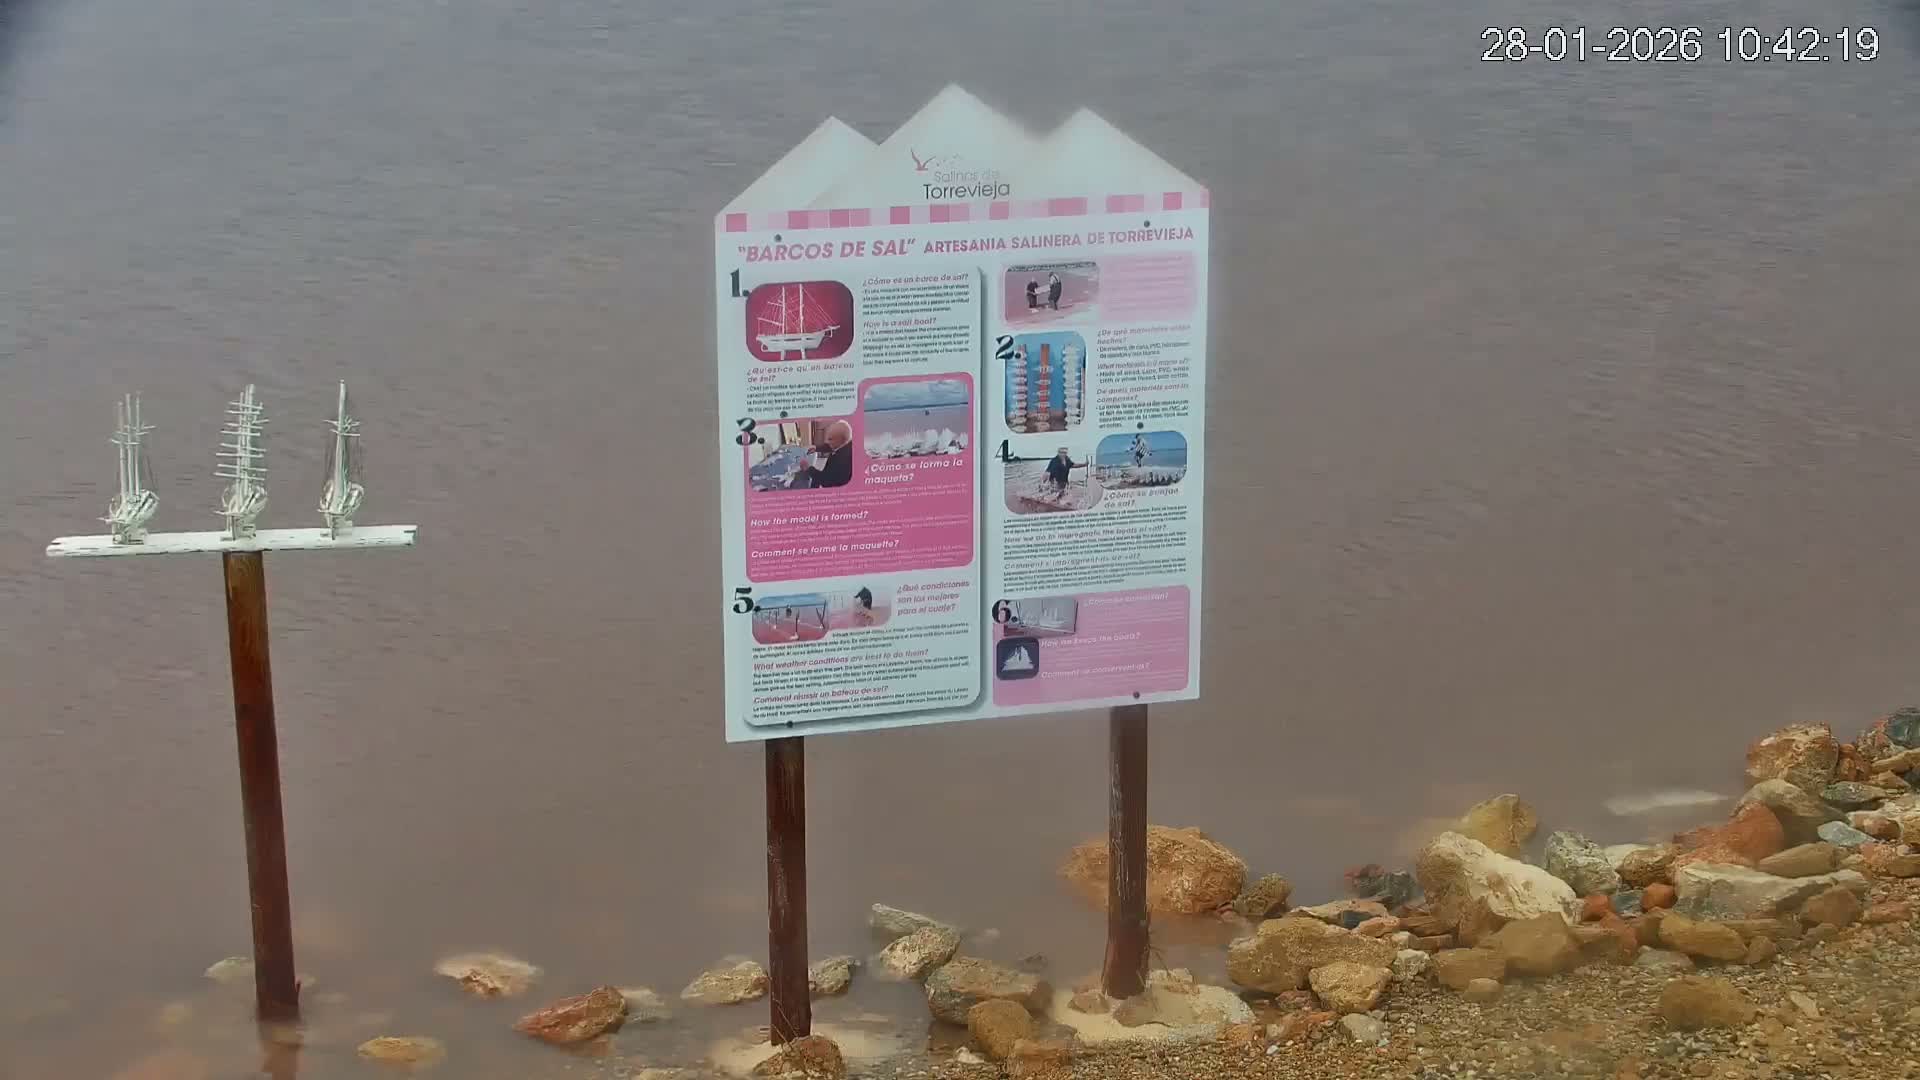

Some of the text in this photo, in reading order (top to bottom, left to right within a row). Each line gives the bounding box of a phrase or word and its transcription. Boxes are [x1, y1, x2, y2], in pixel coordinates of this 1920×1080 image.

[933, 170, 978, 183] Salinas
[923, 181, 1010, 200] Torrevieja
[839, 241, 866, 259] DE
[923, 236, 1007, 254] ARTESANIA
[1011, 233, 1082, 249] SALINERA
[1087, 231, 1105, 246] DE
[1108, 226, 1194, 243] TORREVIEJA
[730, 267, 750, 297] 1.
[995, 335, 1022, 361] 2.
[919, 458, 949, 469] forma
[952, 457, 963, 467] la
[864, 473, 914, 486] maqueta?
[750, 510, 869, 527] How the model is formed?
[751, 539, 900, 559] Comment se forme la maquette?
[920, 580, 970, 592] condiciones
[732, 586, 762, 614] 5.
[897, 596, 913, 605] son
[991, 598, 1018, 624] 6.
[752, 661, 774, 671] What
[775, 659, 807, 670] weather
[808, 655, 849, 667] conditions
[893, 649, 904, 659] do
[753, 693, 792, 704] Comment
[831, 687, 860, 698] bateau
